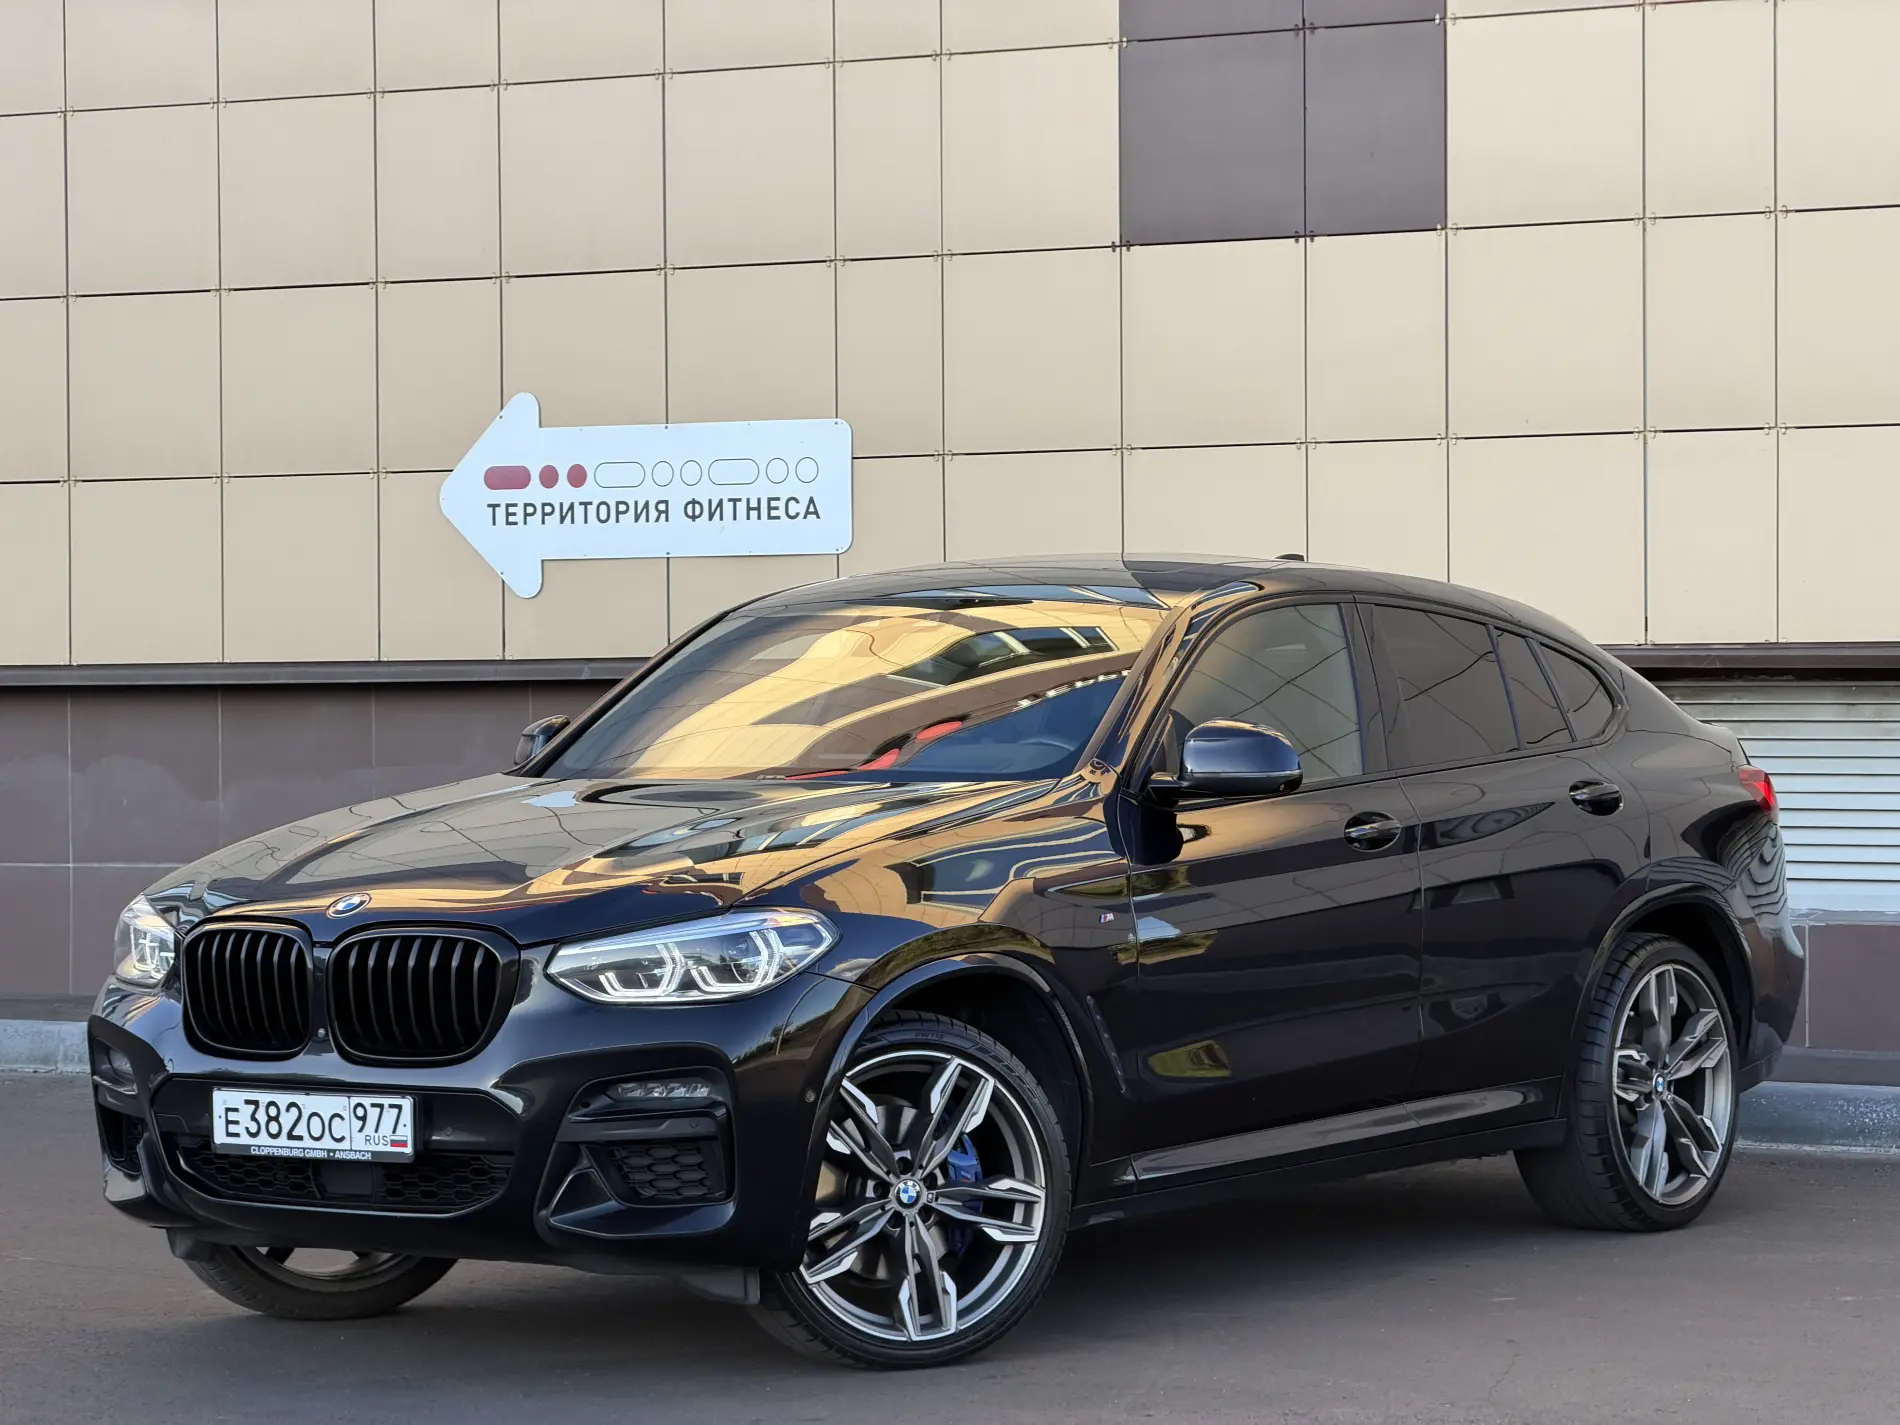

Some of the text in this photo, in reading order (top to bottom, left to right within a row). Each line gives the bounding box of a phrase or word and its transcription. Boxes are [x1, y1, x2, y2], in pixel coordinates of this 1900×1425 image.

[487, 495, 821, 526] ТЕРРИТОРИЯ ФИТНЕСА
[352, 1101, 403, 1135] 977
[364, 1134, 389, 1147] RUS
[250, 1146, 372, 1160] CLOPPENBURG GMBH ANSBACH
